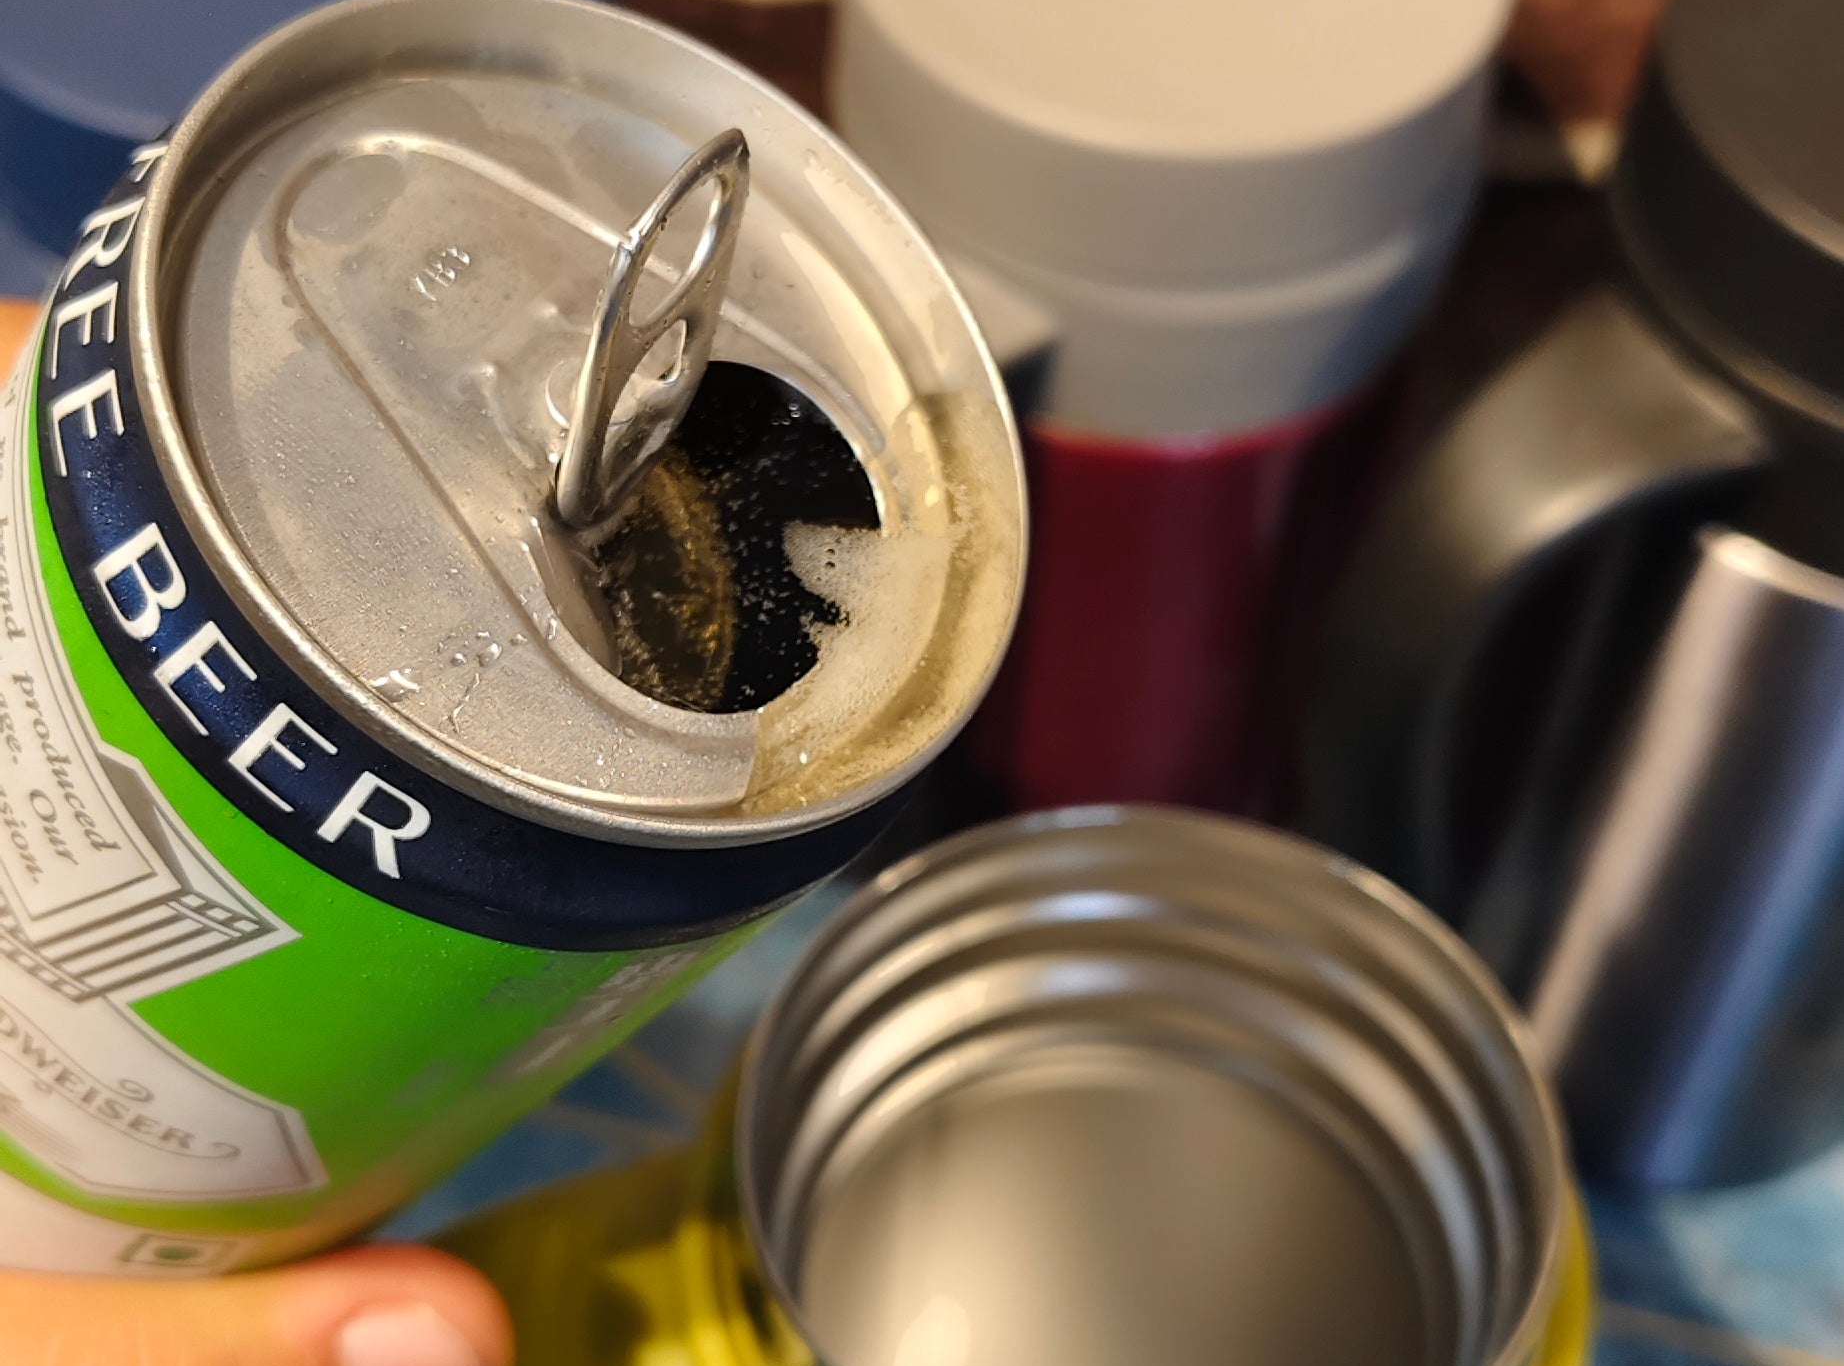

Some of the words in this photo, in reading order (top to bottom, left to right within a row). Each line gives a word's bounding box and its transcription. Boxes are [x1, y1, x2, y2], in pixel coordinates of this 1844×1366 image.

[12, 670, 122, 852] produced
[93, 522, 431, 880] BEER
[29, 787, 80, 867] Our
